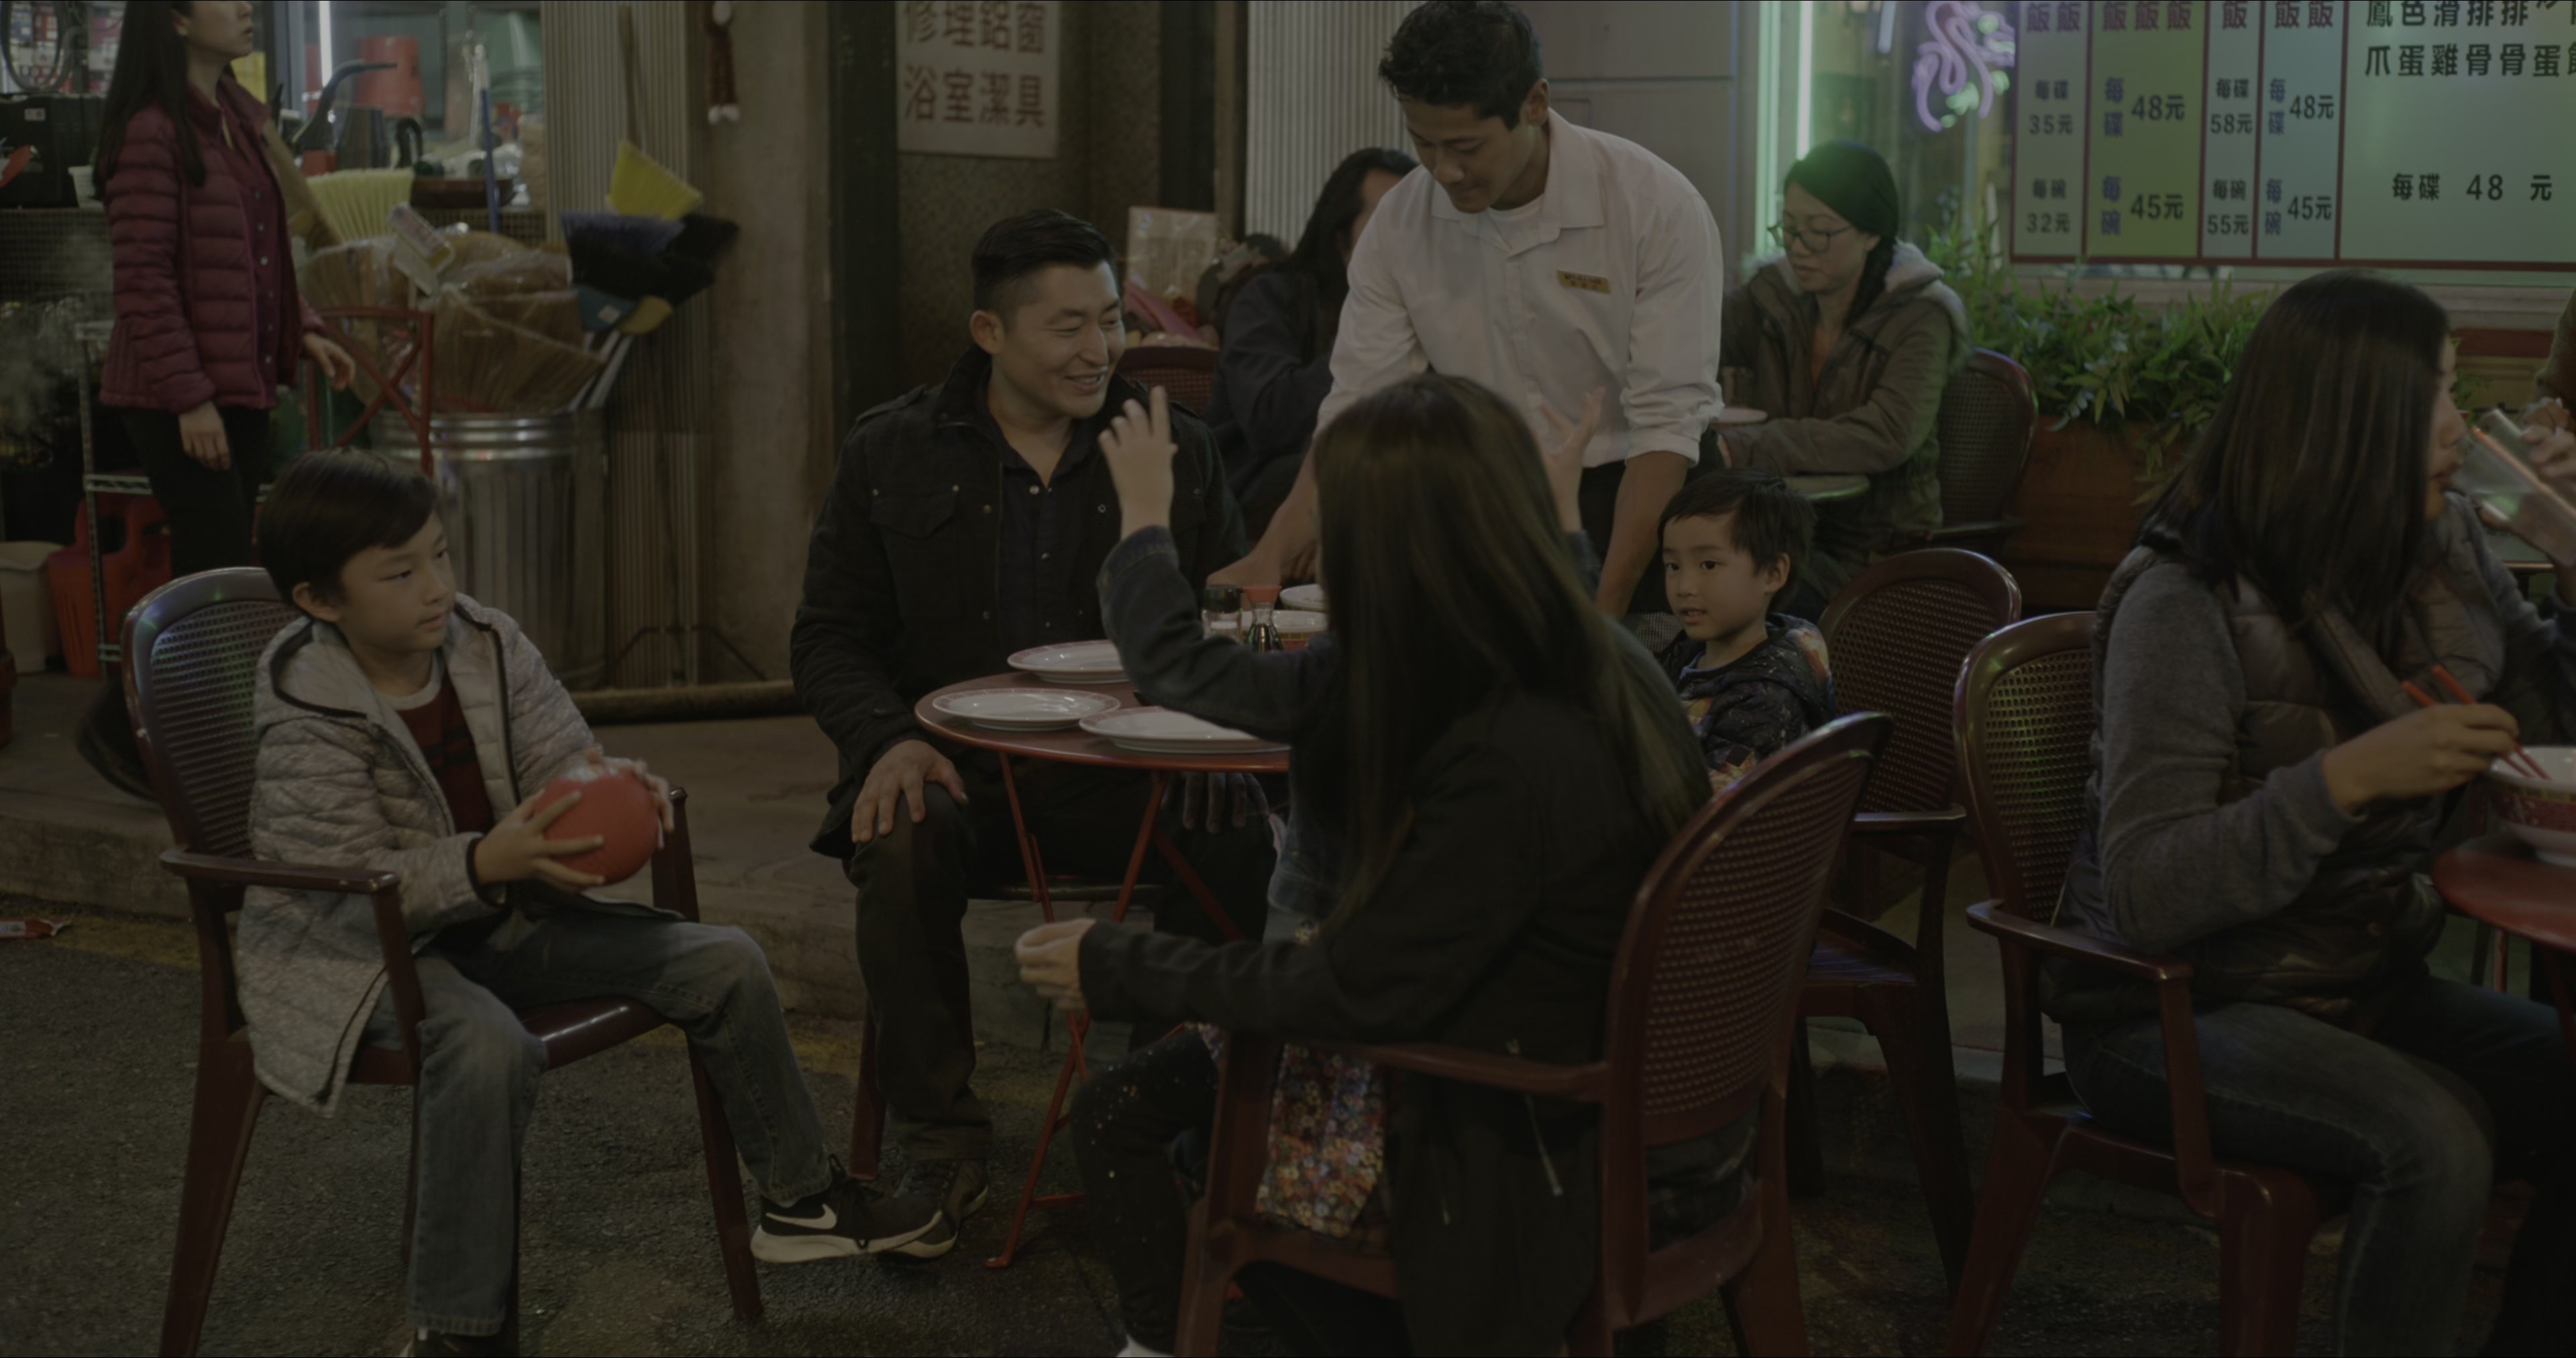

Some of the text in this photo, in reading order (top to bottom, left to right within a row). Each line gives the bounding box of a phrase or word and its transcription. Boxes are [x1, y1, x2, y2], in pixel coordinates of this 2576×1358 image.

[2134, 1, 2158, 30] 飯
[2167, 1, 2191, 31] 飯
[2222, 1, 2247, 30] 飯
[2275, 1, 2300, 29] 飯
[2307, 1, 2333, 28] 飯
[904, 65, 1044, 127] 浴室潔具
[2216, 78, 2249, 99] 每碟
[2131, 95, 2185, 121] 48元
[2289, 95, 2334, 119] 48元
[2210, 113, 2253, 135] 58元
[2212, 179, 2247, 201] 每碗
[2392, 172, 2553, 201] 每碟 48 元
[2130, 193, 2184, 220] 45元
[2287, 195, 2332, 221] 45元
[2207, 213, 2249, 235] 55元
